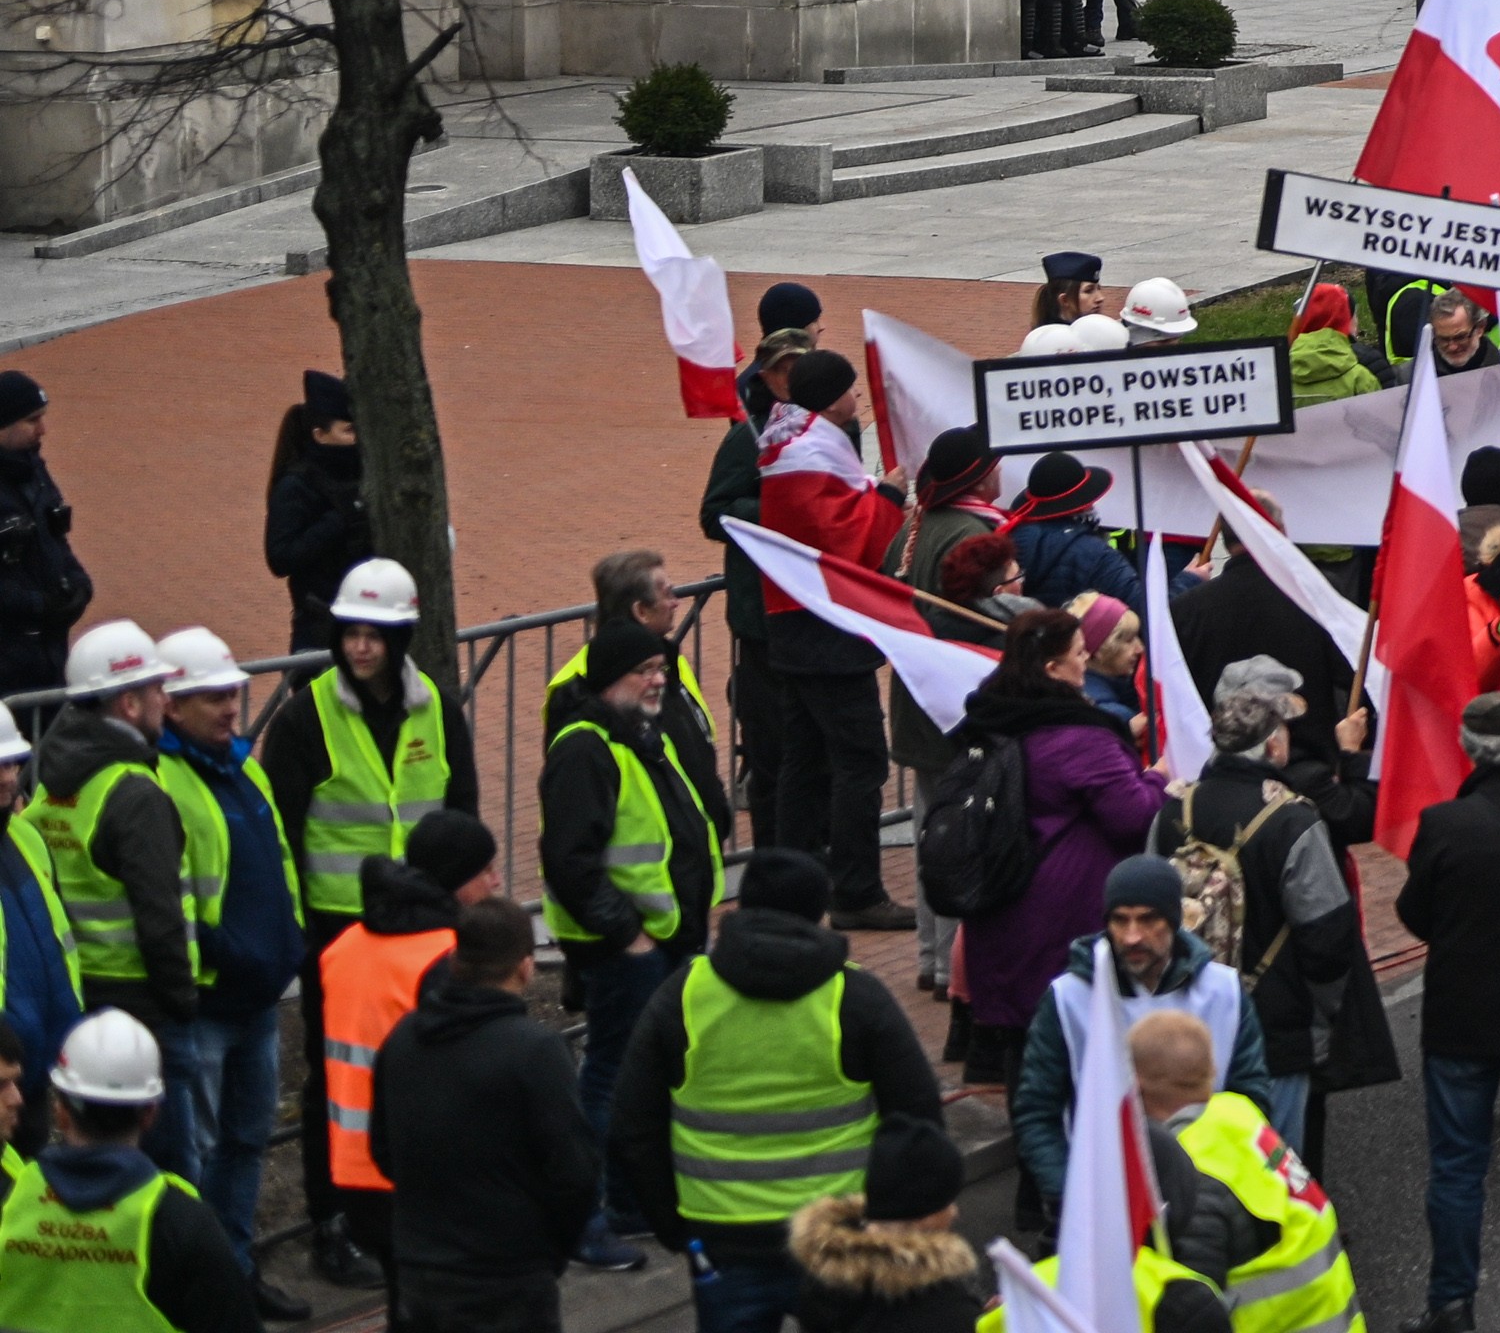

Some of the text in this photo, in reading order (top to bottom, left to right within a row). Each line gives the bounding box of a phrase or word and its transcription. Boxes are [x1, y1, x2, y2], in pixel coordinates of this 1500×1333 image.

[1304, 195, 1432, 235] WSZYSCY
[1006, 357, 1257, 402] EUROPO, POWSTAŃ!
[1019, 393, 1247, 431] EUROPE, RISE UP!
